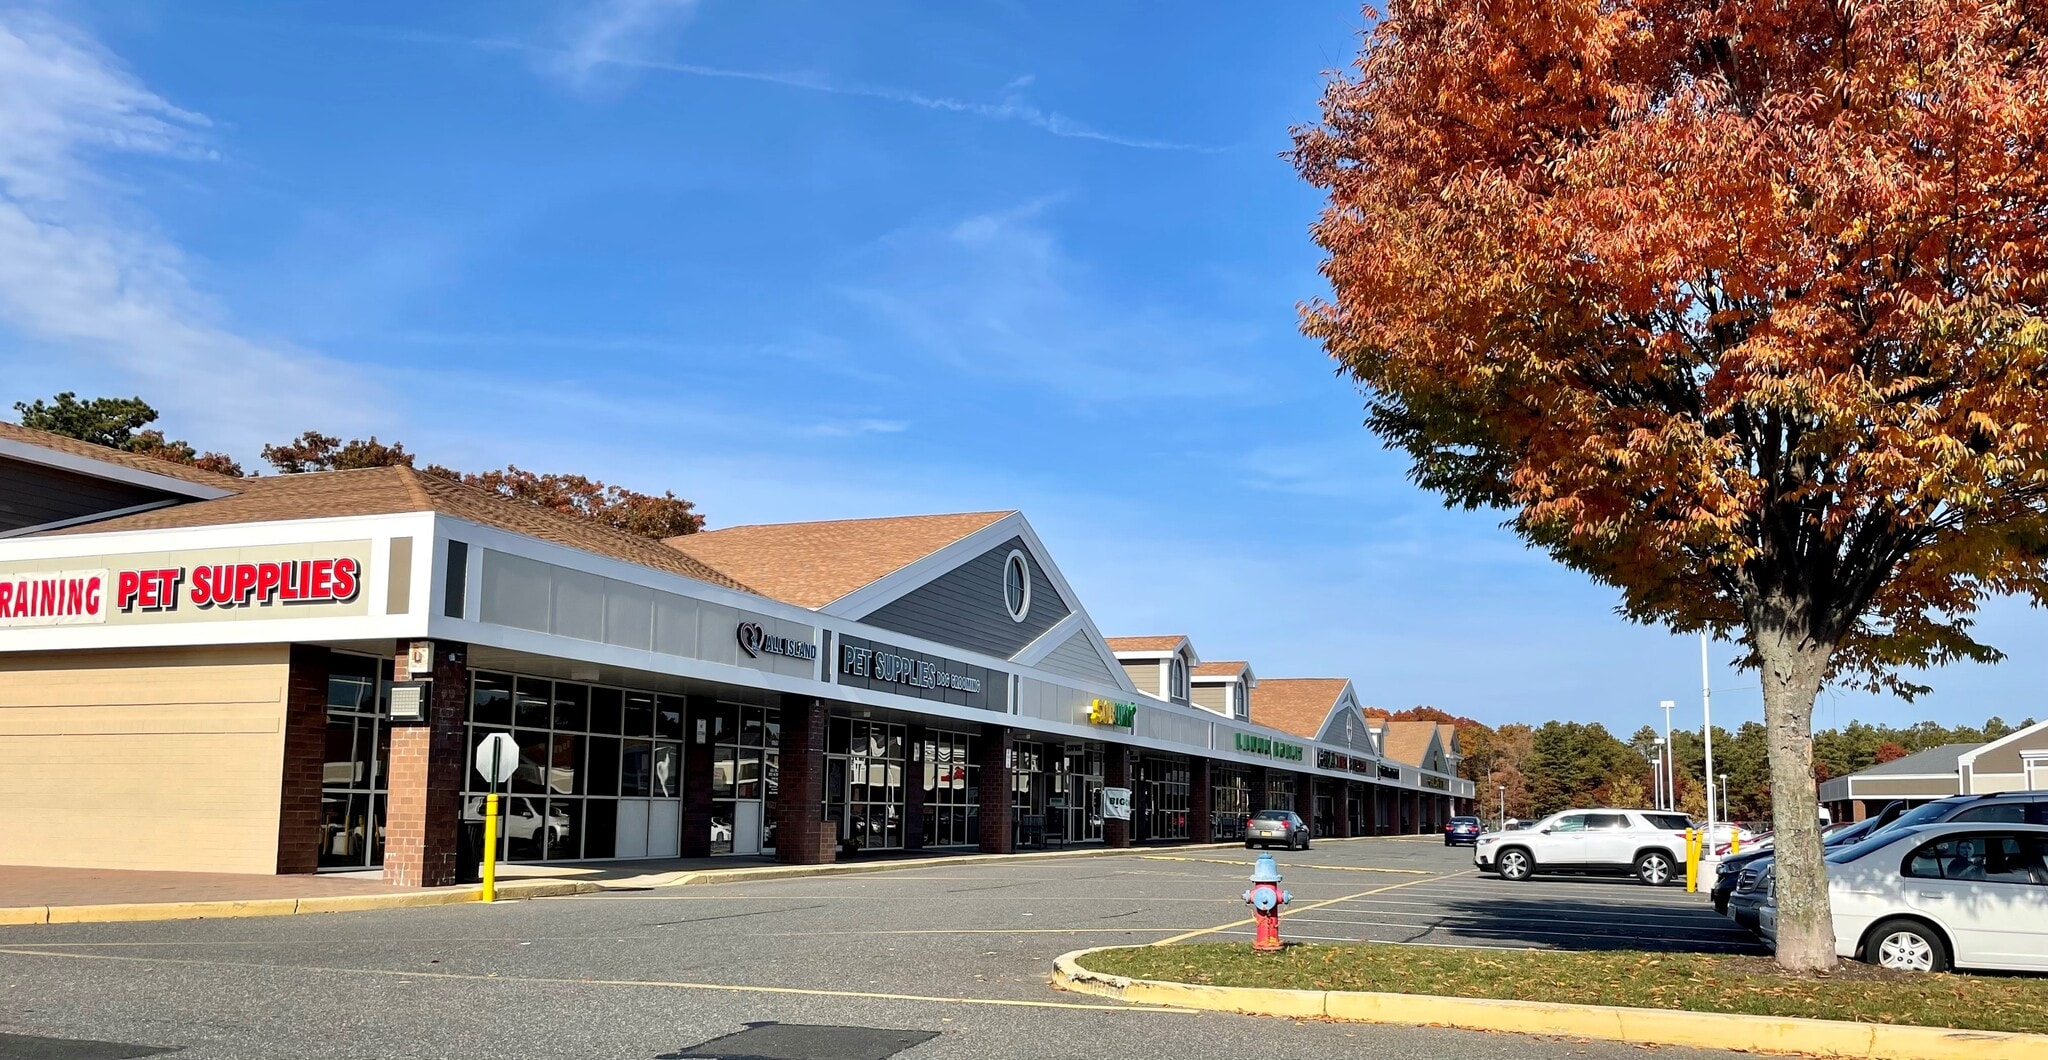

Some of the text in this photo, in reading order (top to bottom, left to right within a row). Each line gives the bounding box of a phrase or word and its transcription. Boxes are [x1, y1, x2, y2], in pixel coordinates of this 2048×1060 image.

[117, 557, 362, 613] PET SUPPLIES
[764, 634, 816, 660] ALL ISLAND
[843, 644, 936, 690] PET SUPPLIES
[936, 671, 981, 694] DOG GROOMING
